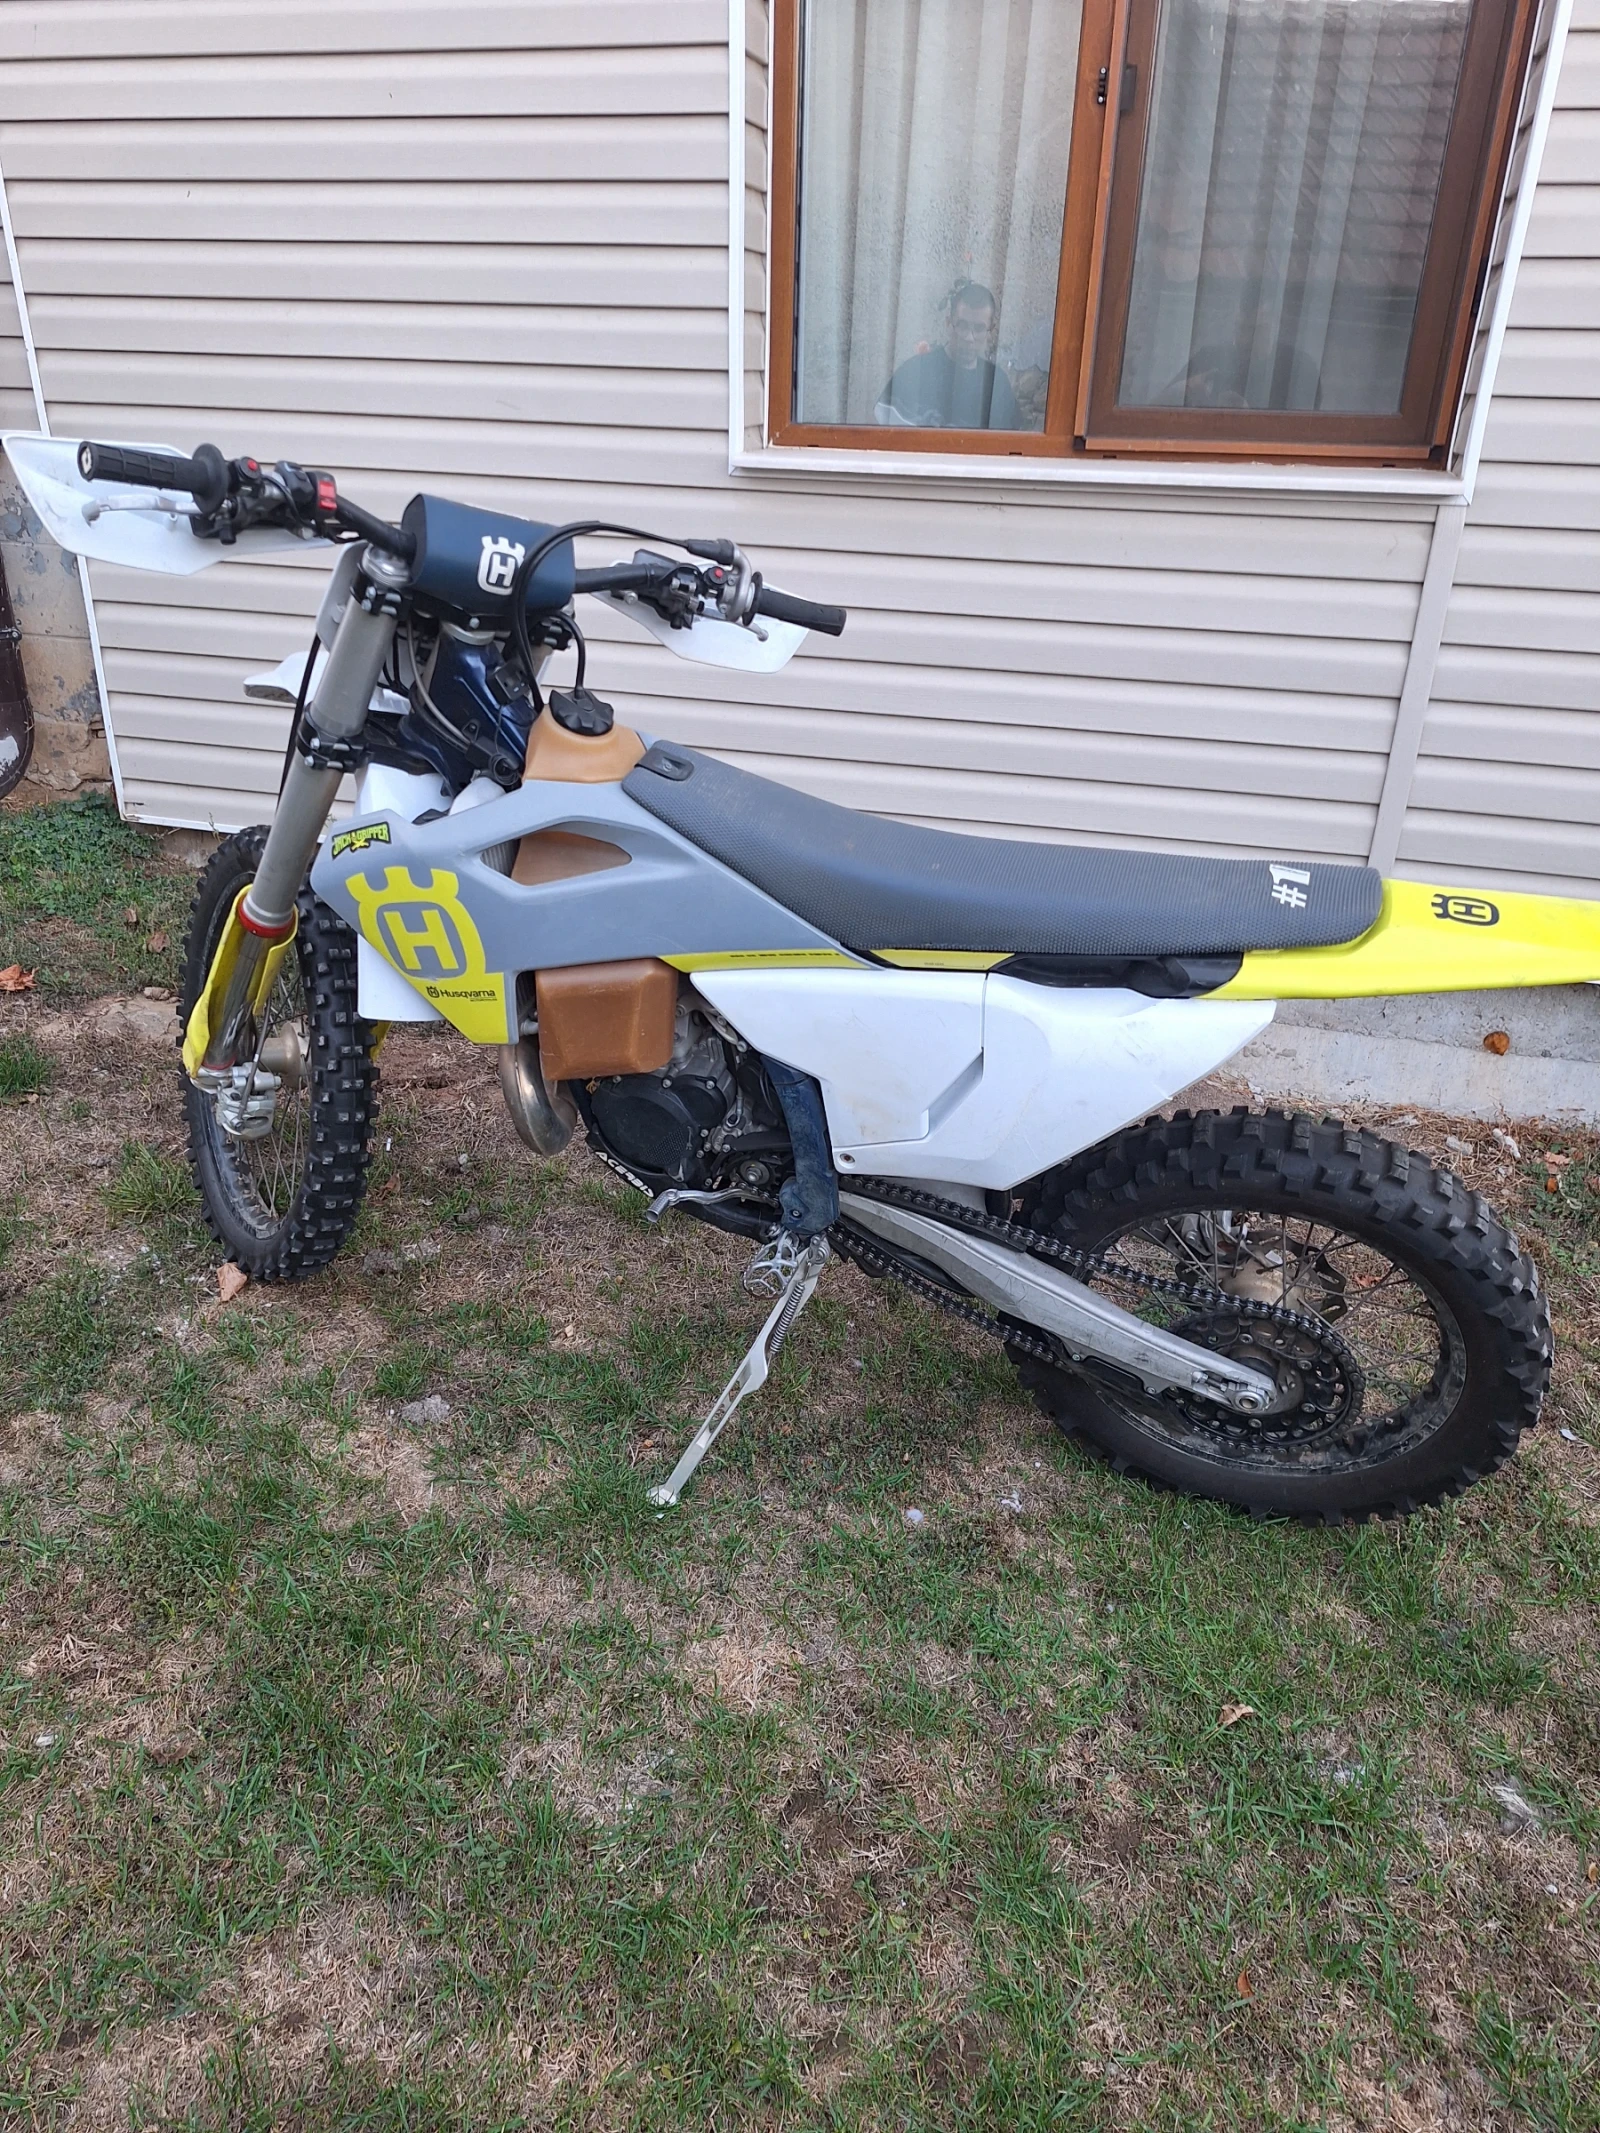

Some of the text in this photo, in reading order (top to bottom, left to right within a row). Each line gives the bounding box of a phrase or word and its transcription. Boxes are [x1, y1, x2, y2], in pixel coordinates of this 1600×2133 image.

[1269, 864, 1310, 908] #1
[440, 989, 496, 999] Husqvarna
[595, 1151, 654, 1198] ACERBIS
